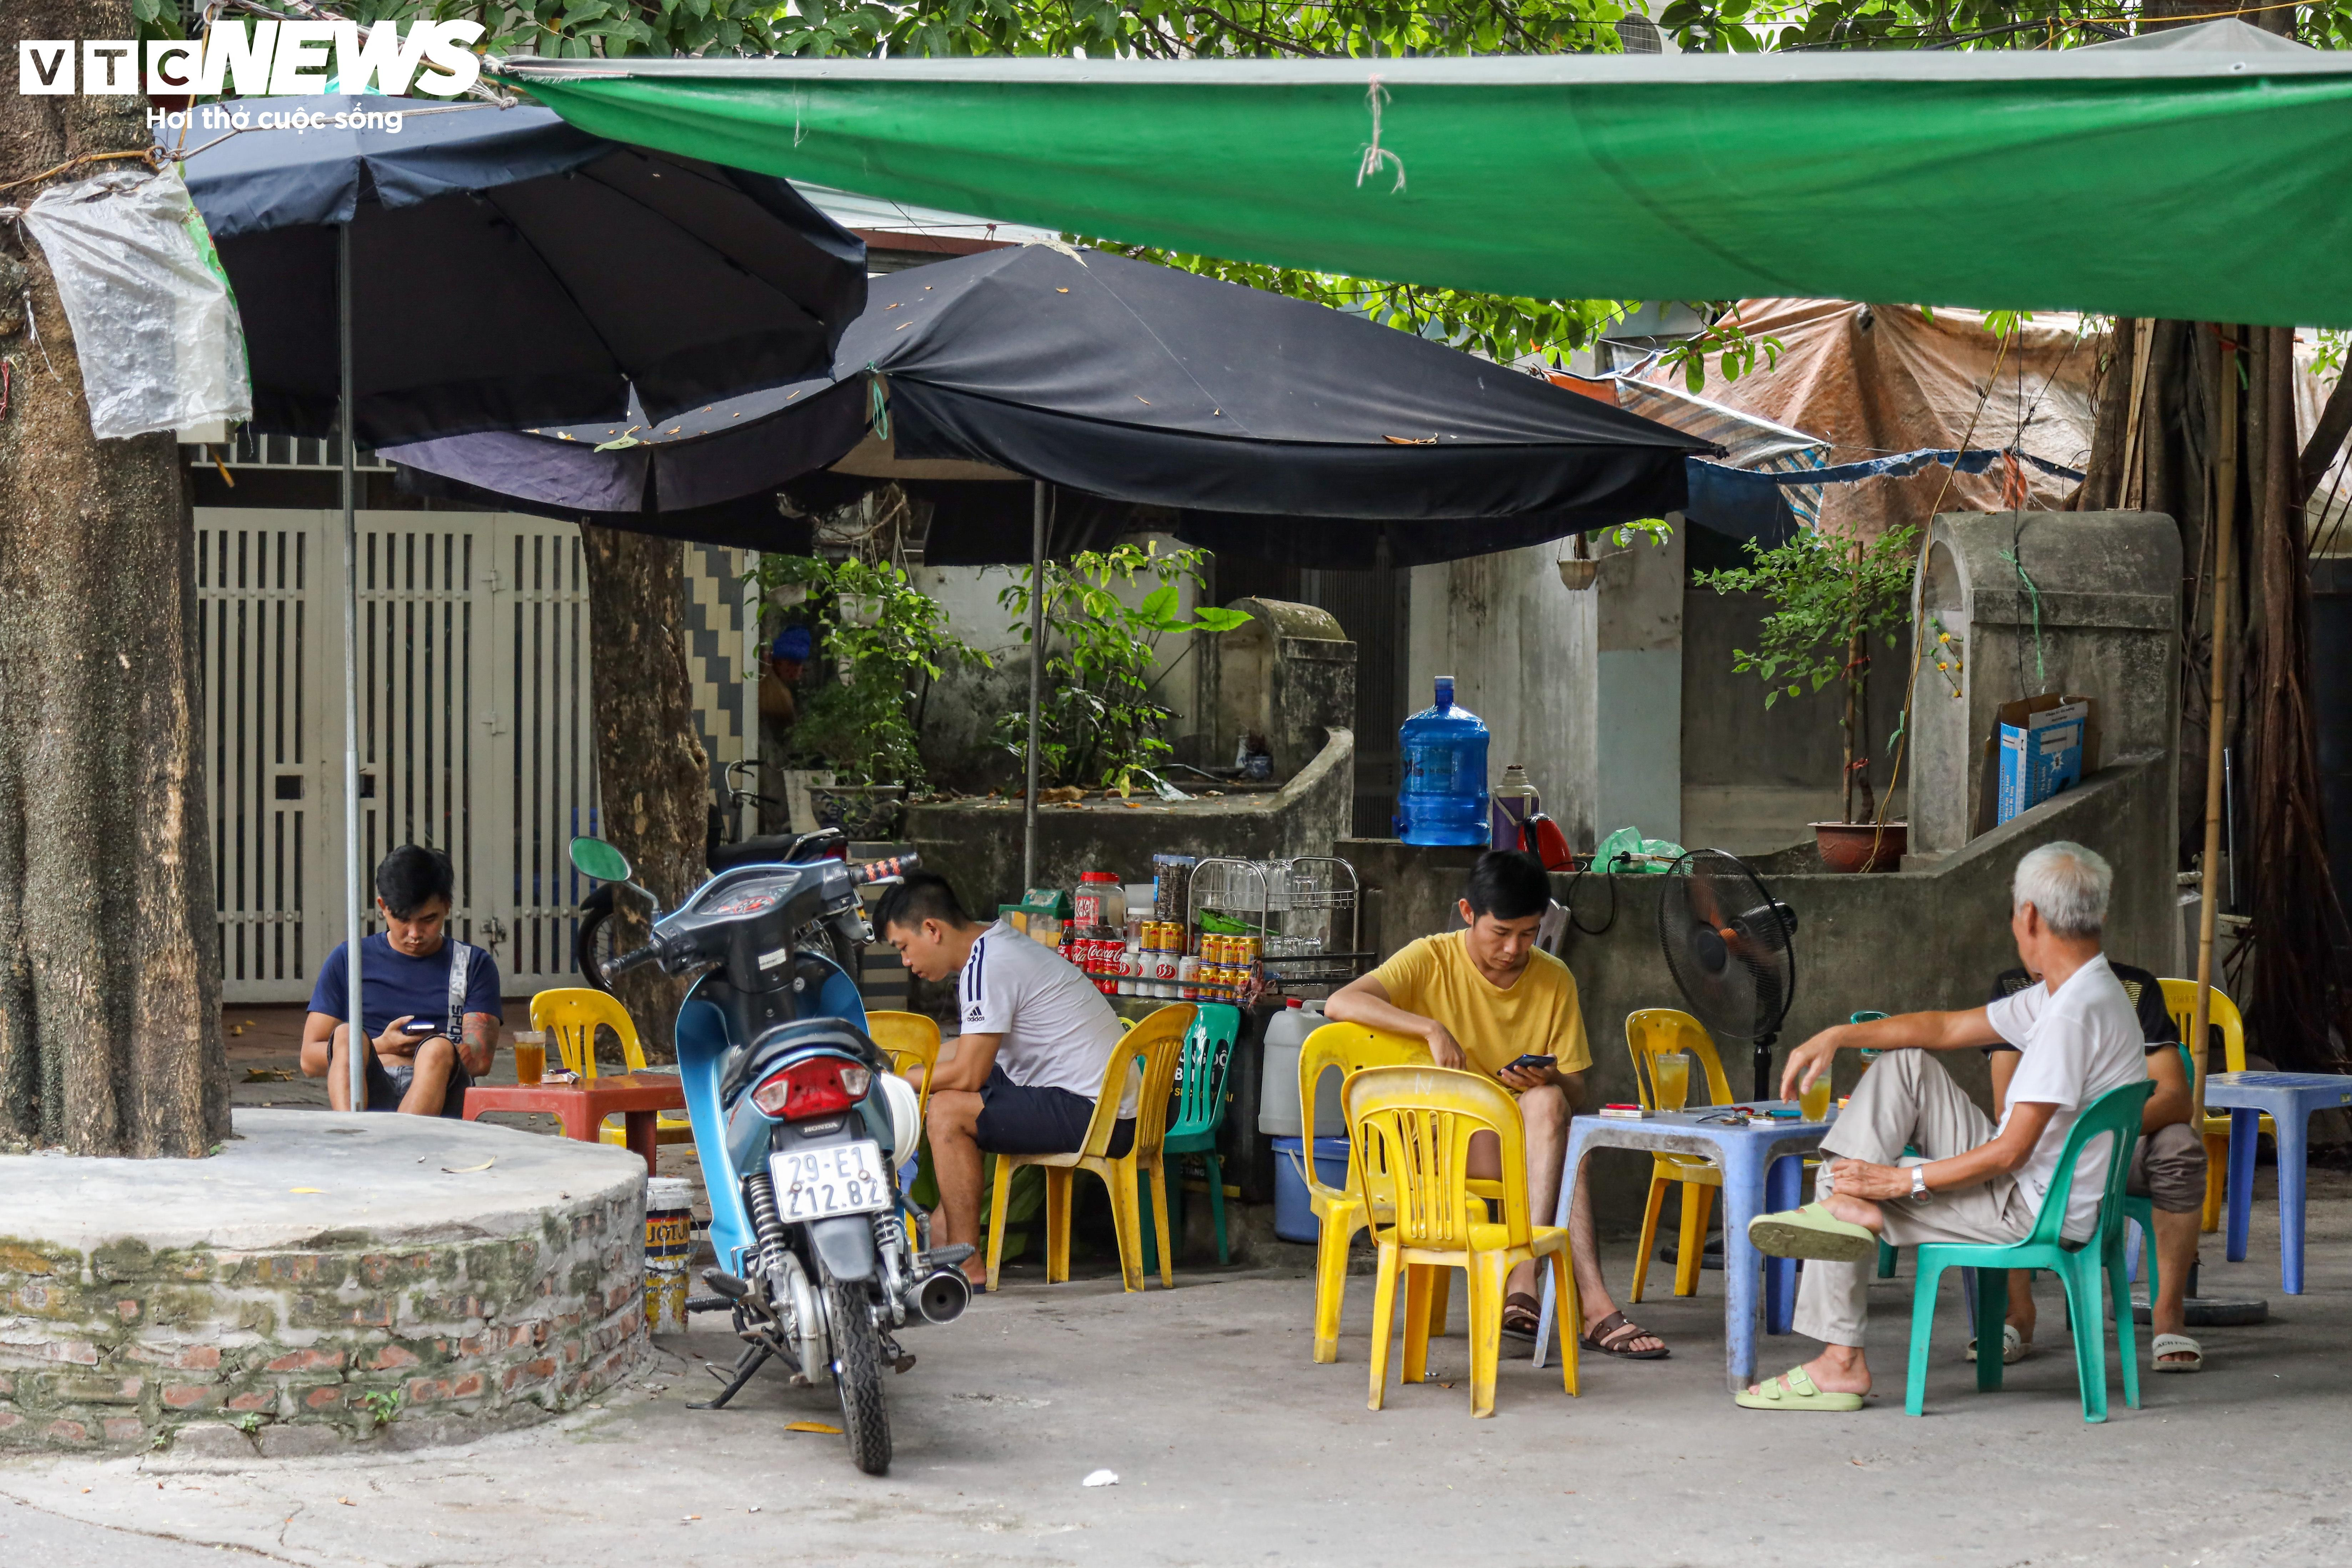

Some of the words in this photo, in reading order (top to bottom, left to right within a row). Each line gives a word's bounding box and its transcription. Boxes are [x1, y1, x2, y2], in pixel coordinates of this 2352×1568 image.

[1157, 963, 1172, 977] 333
[1415, 1072, 1434, 1095] N
[804, 1122, 839, 1133] HONDA
